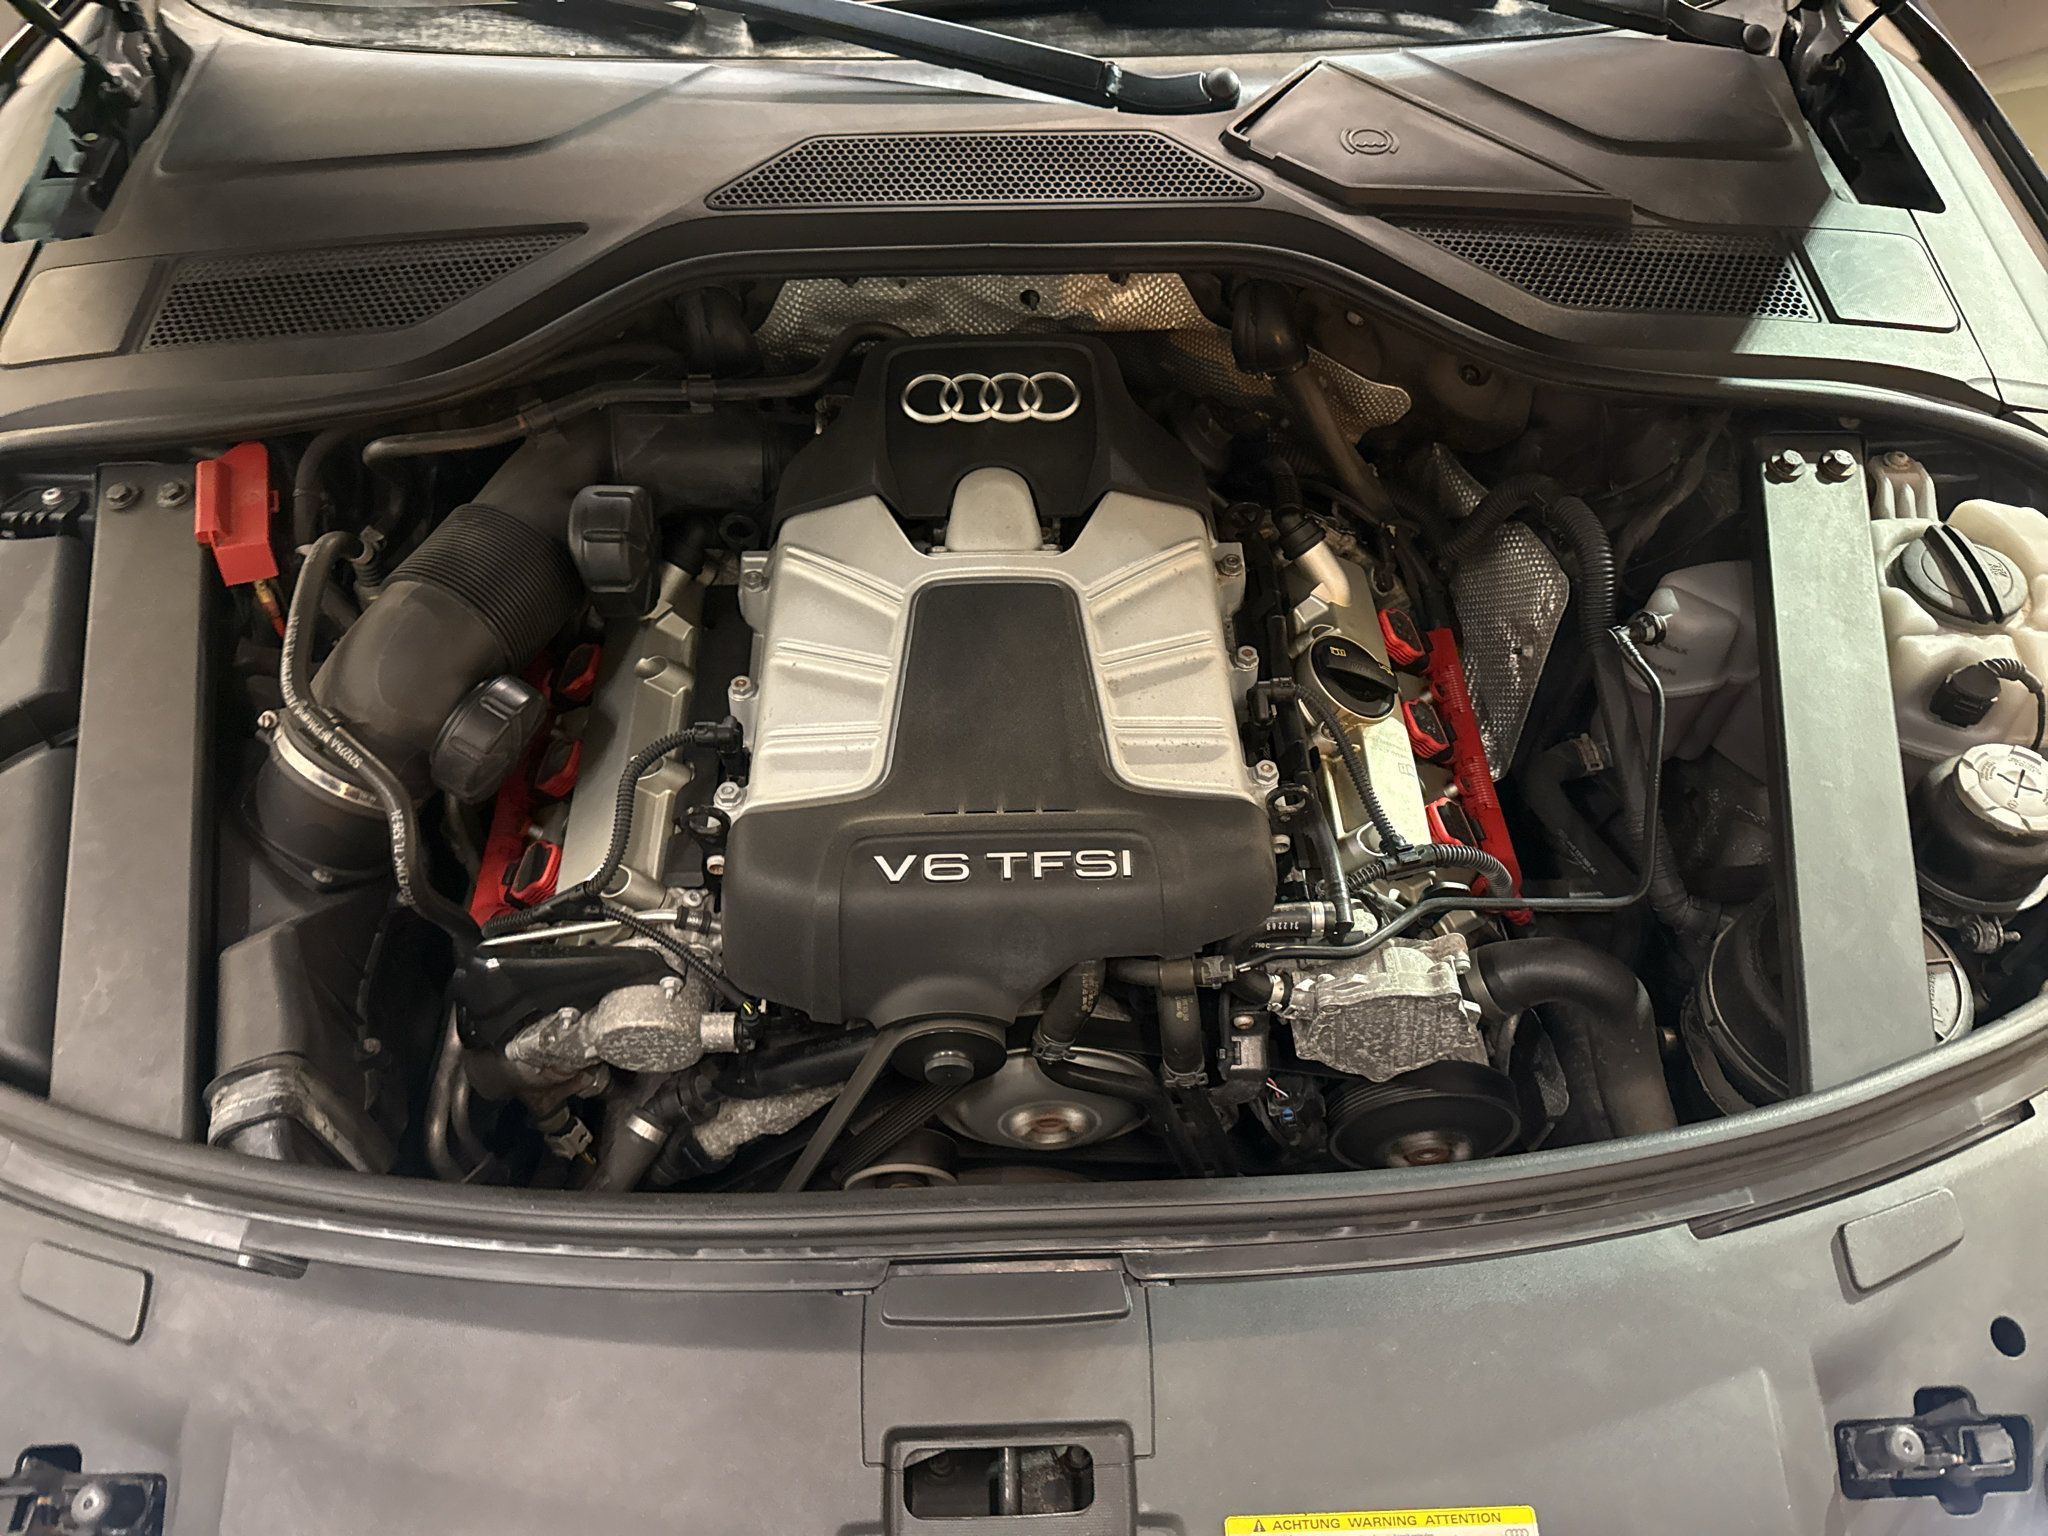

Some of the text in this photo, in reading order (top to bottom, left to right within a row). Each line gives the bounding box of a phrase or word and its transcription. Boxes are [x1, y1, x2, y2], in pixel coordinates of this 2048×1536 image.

[873, 849, 1133, 882] V6 TFSI
[1272, 1512, 1502, 1531] ACHTUNG WARNING ATTENTION
